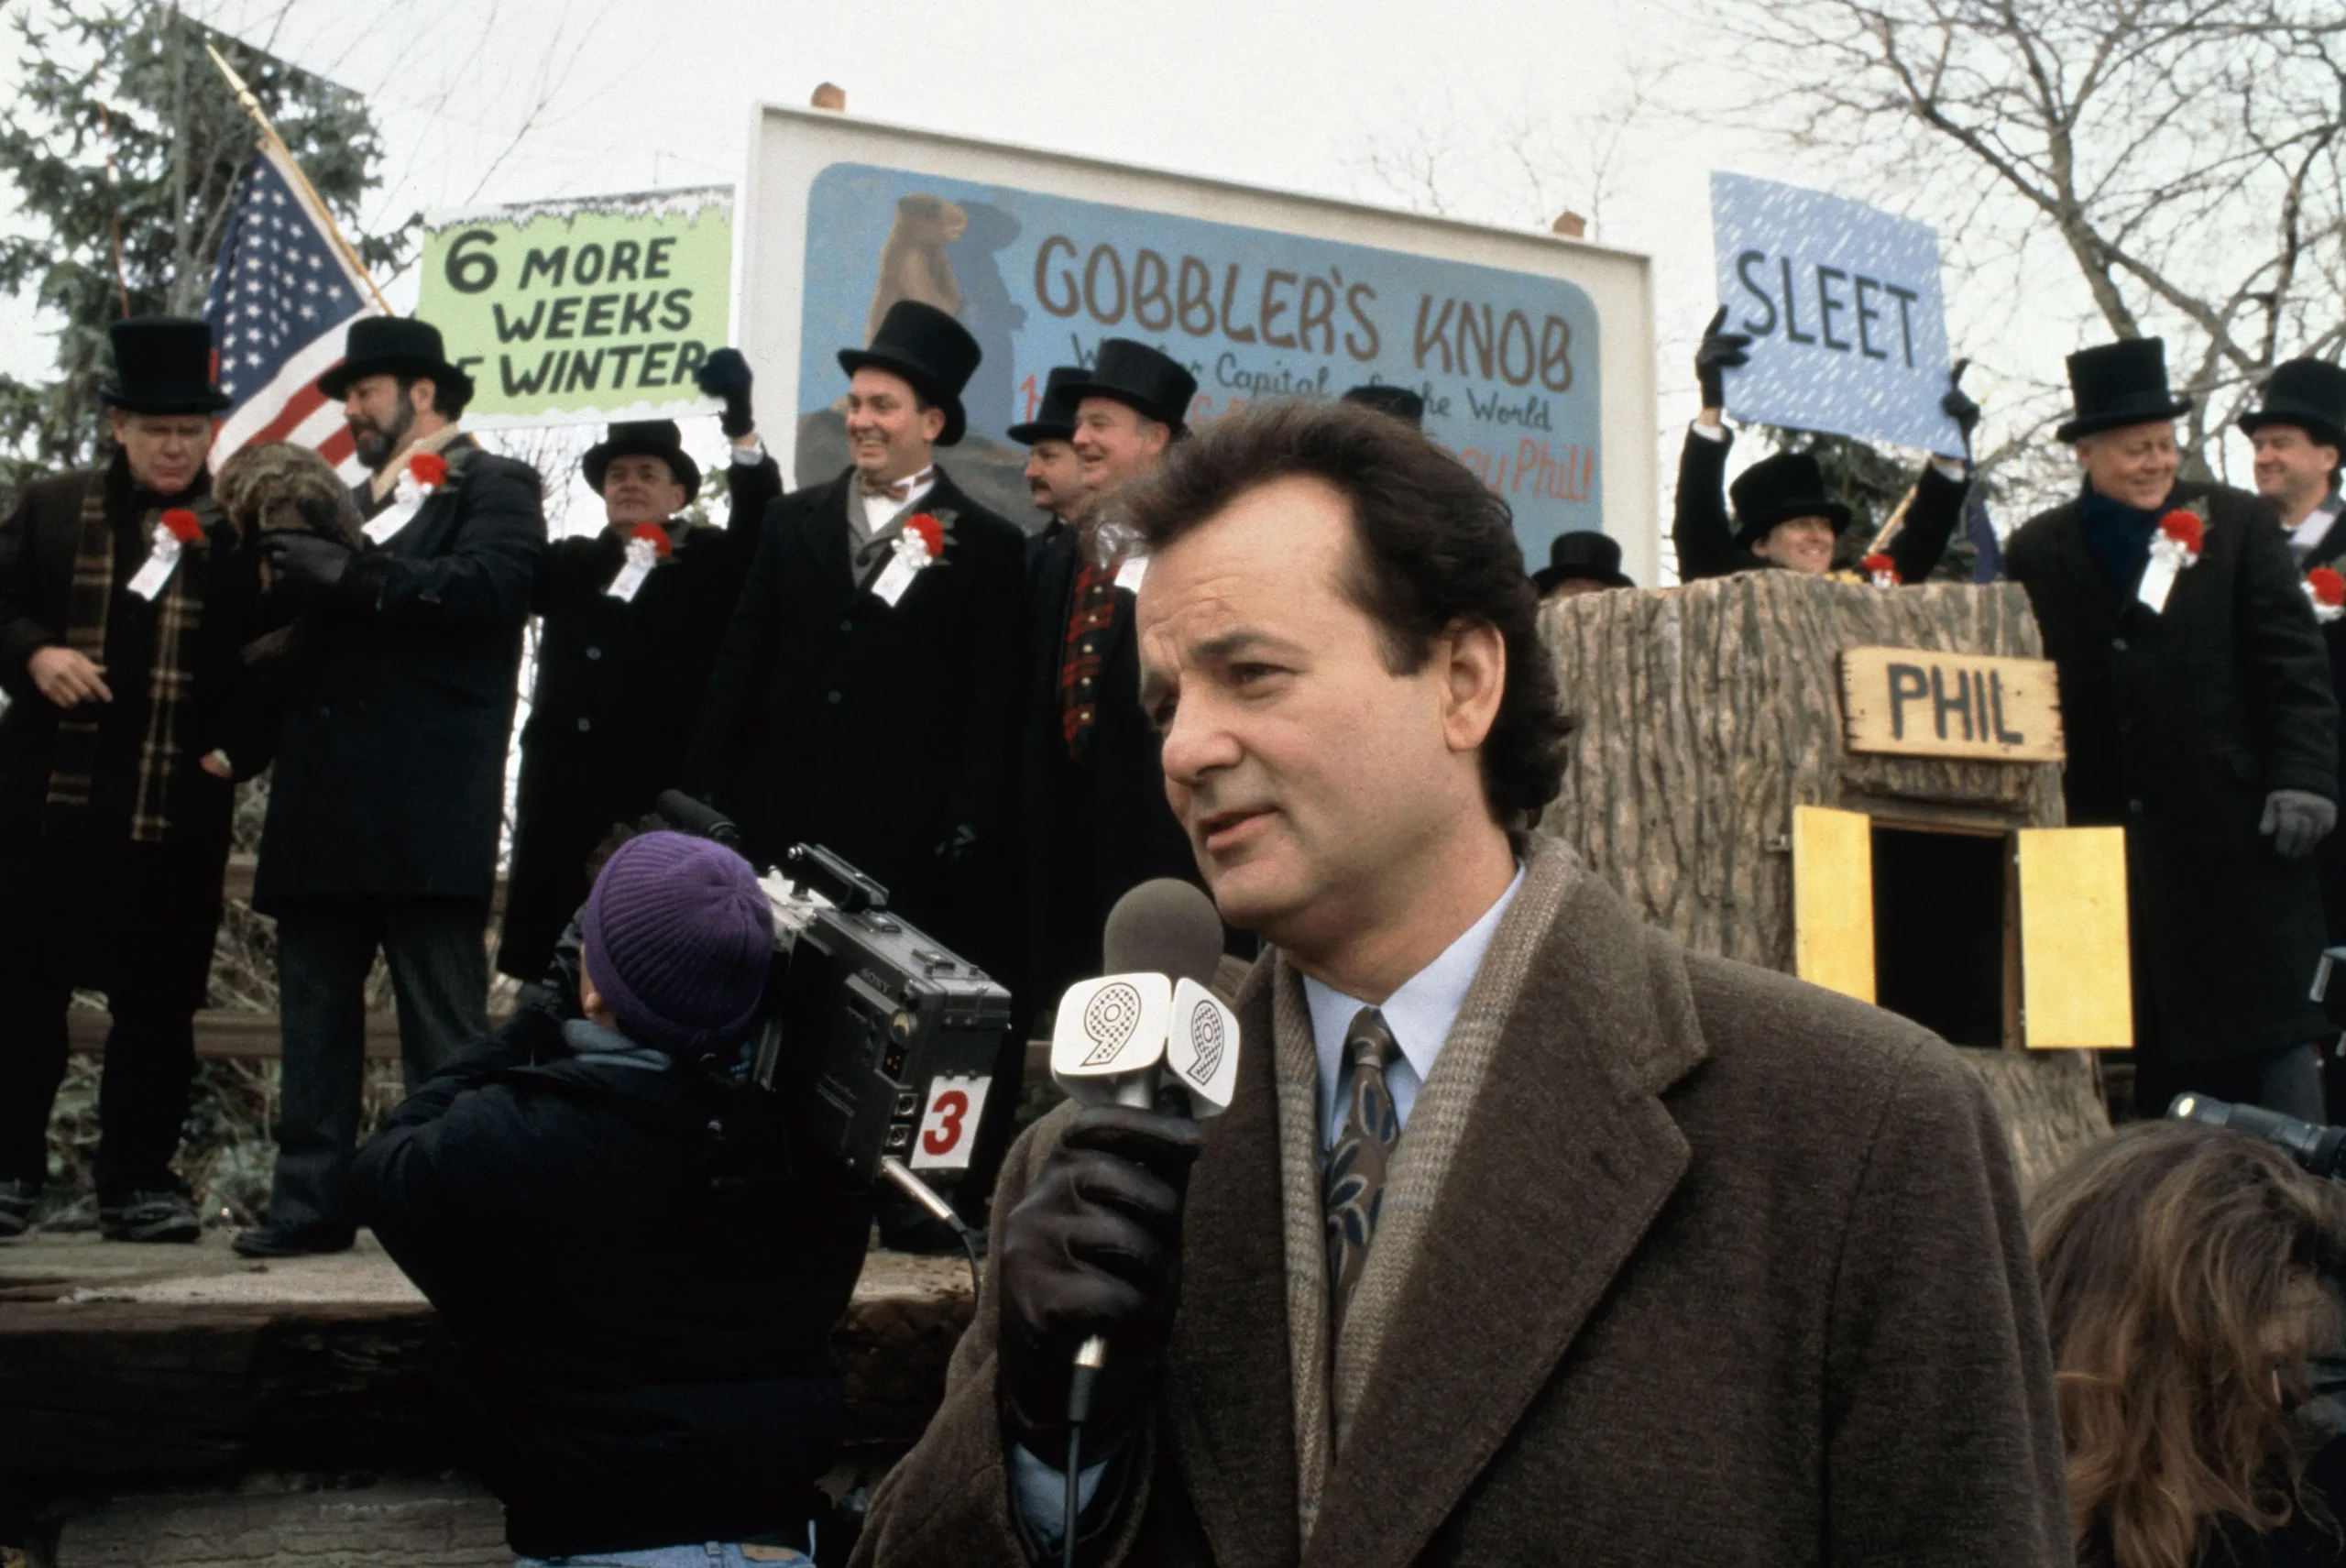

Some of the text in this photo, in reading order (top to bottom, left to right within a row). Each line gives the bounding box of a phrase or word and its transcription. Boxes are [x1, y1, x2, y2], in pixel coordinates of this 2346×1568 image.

[444, 229, 677, 294] 6 MORE
[493, 288, 694, 344] WEEKS
[1034, 234, 1381, 363] GOBBLER'S
[1412, 293, 1574, 394] KNOB
[1737, 249, 1918, 368] SLEET
[498, 340, 708, 398] WINTER
[1215, 351, 1329, 398] Capital
[1421, 380, 1451, 417] he
[1466, 387, 1553, 434] World
[1510, 436, 1595, 501] Phil!
[1887, 663, 2024, 746] PHIL
[1080, 981, 1142, 1068] 9
[1186, 999, 1225, 1086] 9
[922, 1090, 970, 1156] 3
